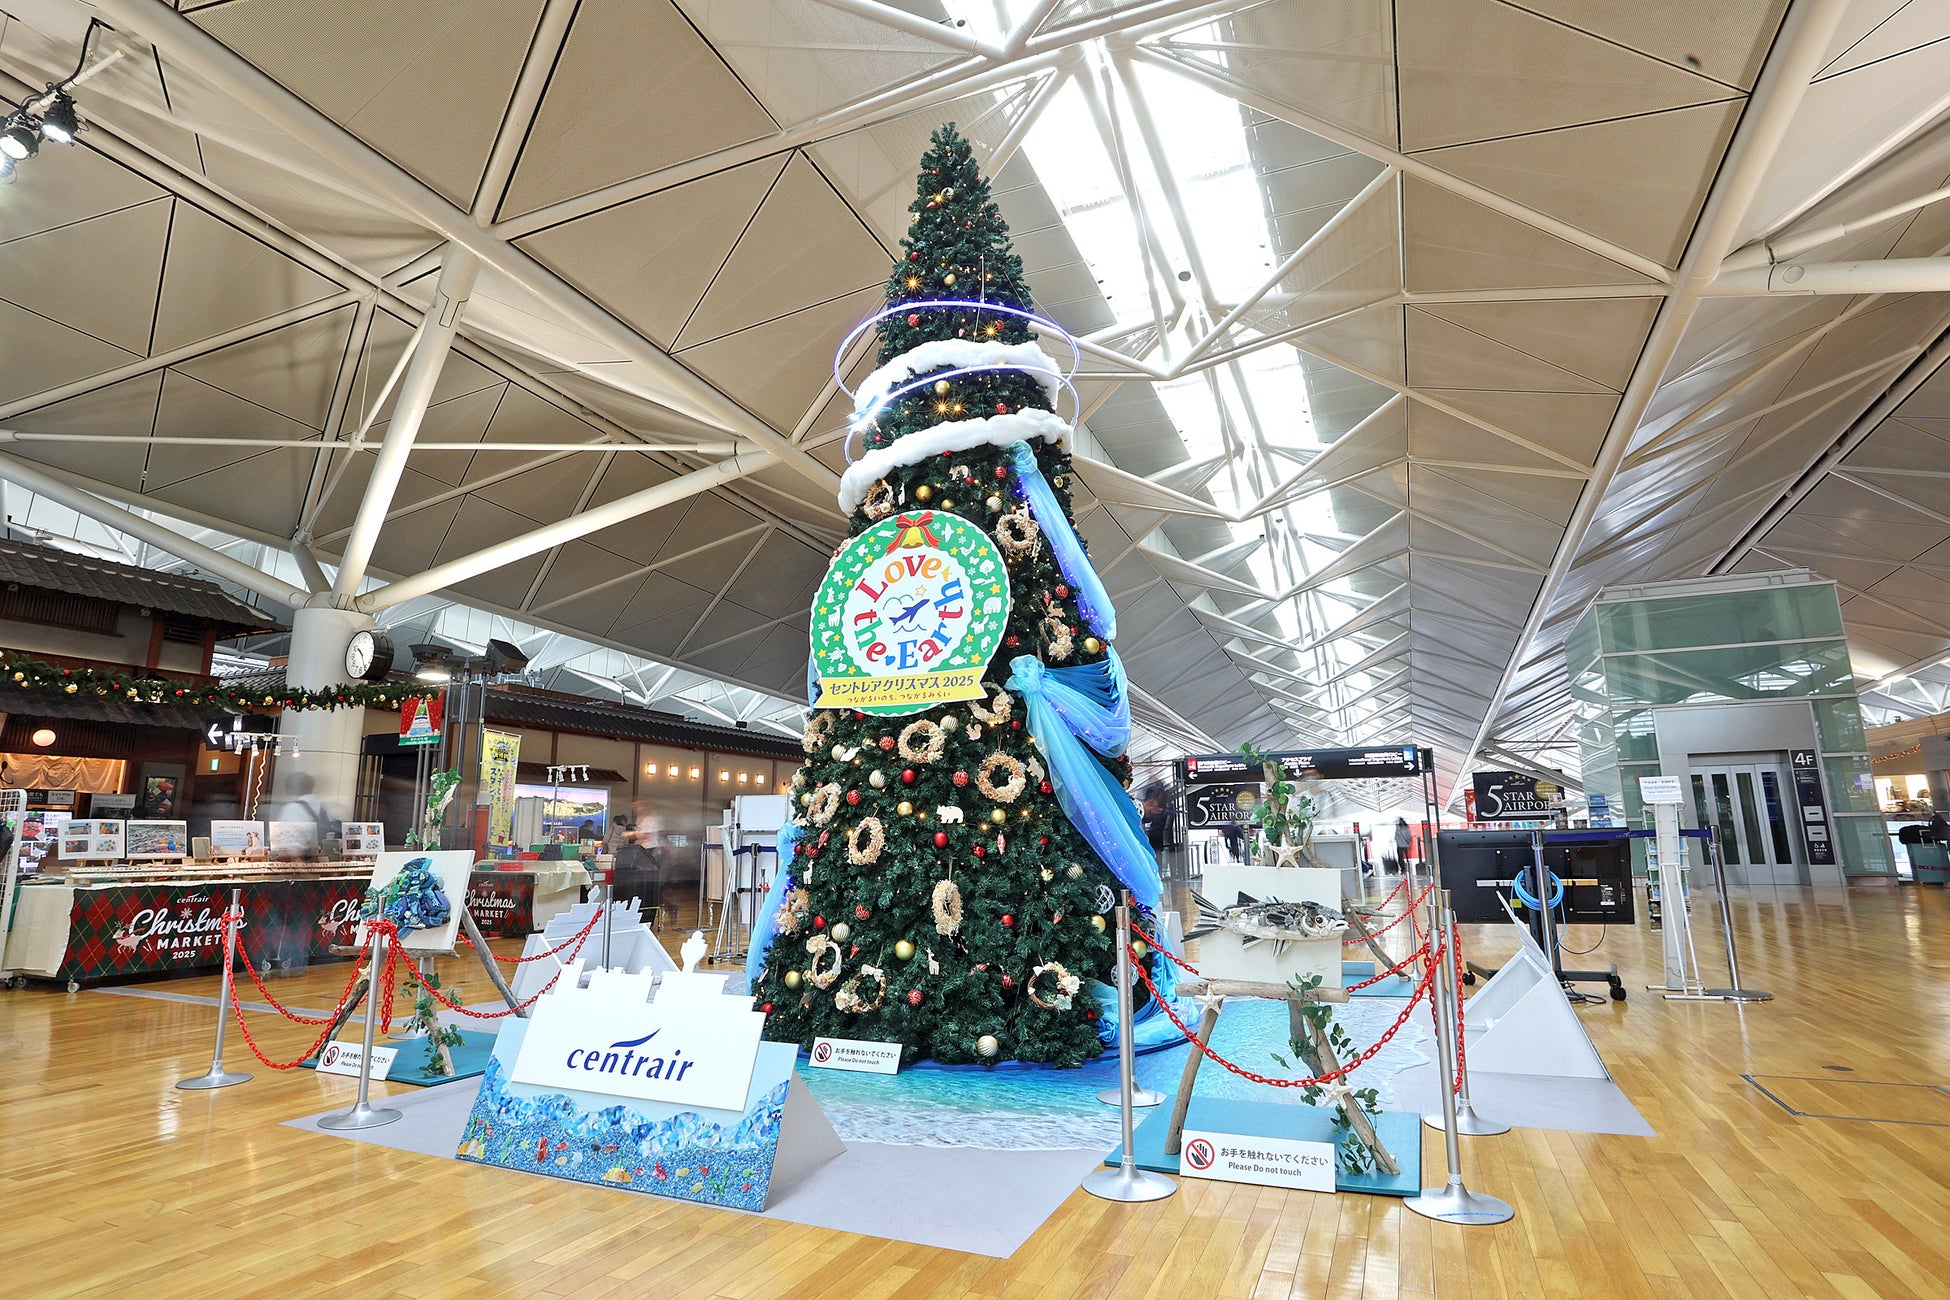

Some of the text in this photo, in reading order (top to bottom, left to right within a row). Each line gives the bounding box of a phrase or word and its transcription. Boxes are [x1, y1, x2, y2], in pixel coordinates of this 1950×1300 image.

[855, 554, 942, 603] Love
[897, 578, 964, 670] Earth
[853, 609, 887, 662] the
[829, 675, 974, 695] セントレアクリスマス 2025
[1795, 752, 1814, 766] 4F
[1480, 785, 1504, 817] 5
[1503, 791, 1535, 801] STAR
[1190, 796, 1210, 826] 5
[1209, 803, 1236, 811] STAR
[176, 894, 210, 904] centrair
[473, 909, 504, 918] MARKET
[129, 907, 247, 938] Christms
[157, 934, 222, 950] MARKET
[172, 950, 196, 959] 2025
[835, 1047, 897, 1059] お手を触れないでください
[566, 1048, 694, 1082] centrair
[1220, 1147, 1329, 1166] お手を触れないでください
[1228, 1162, 1302, 1177] Please Do not touch
